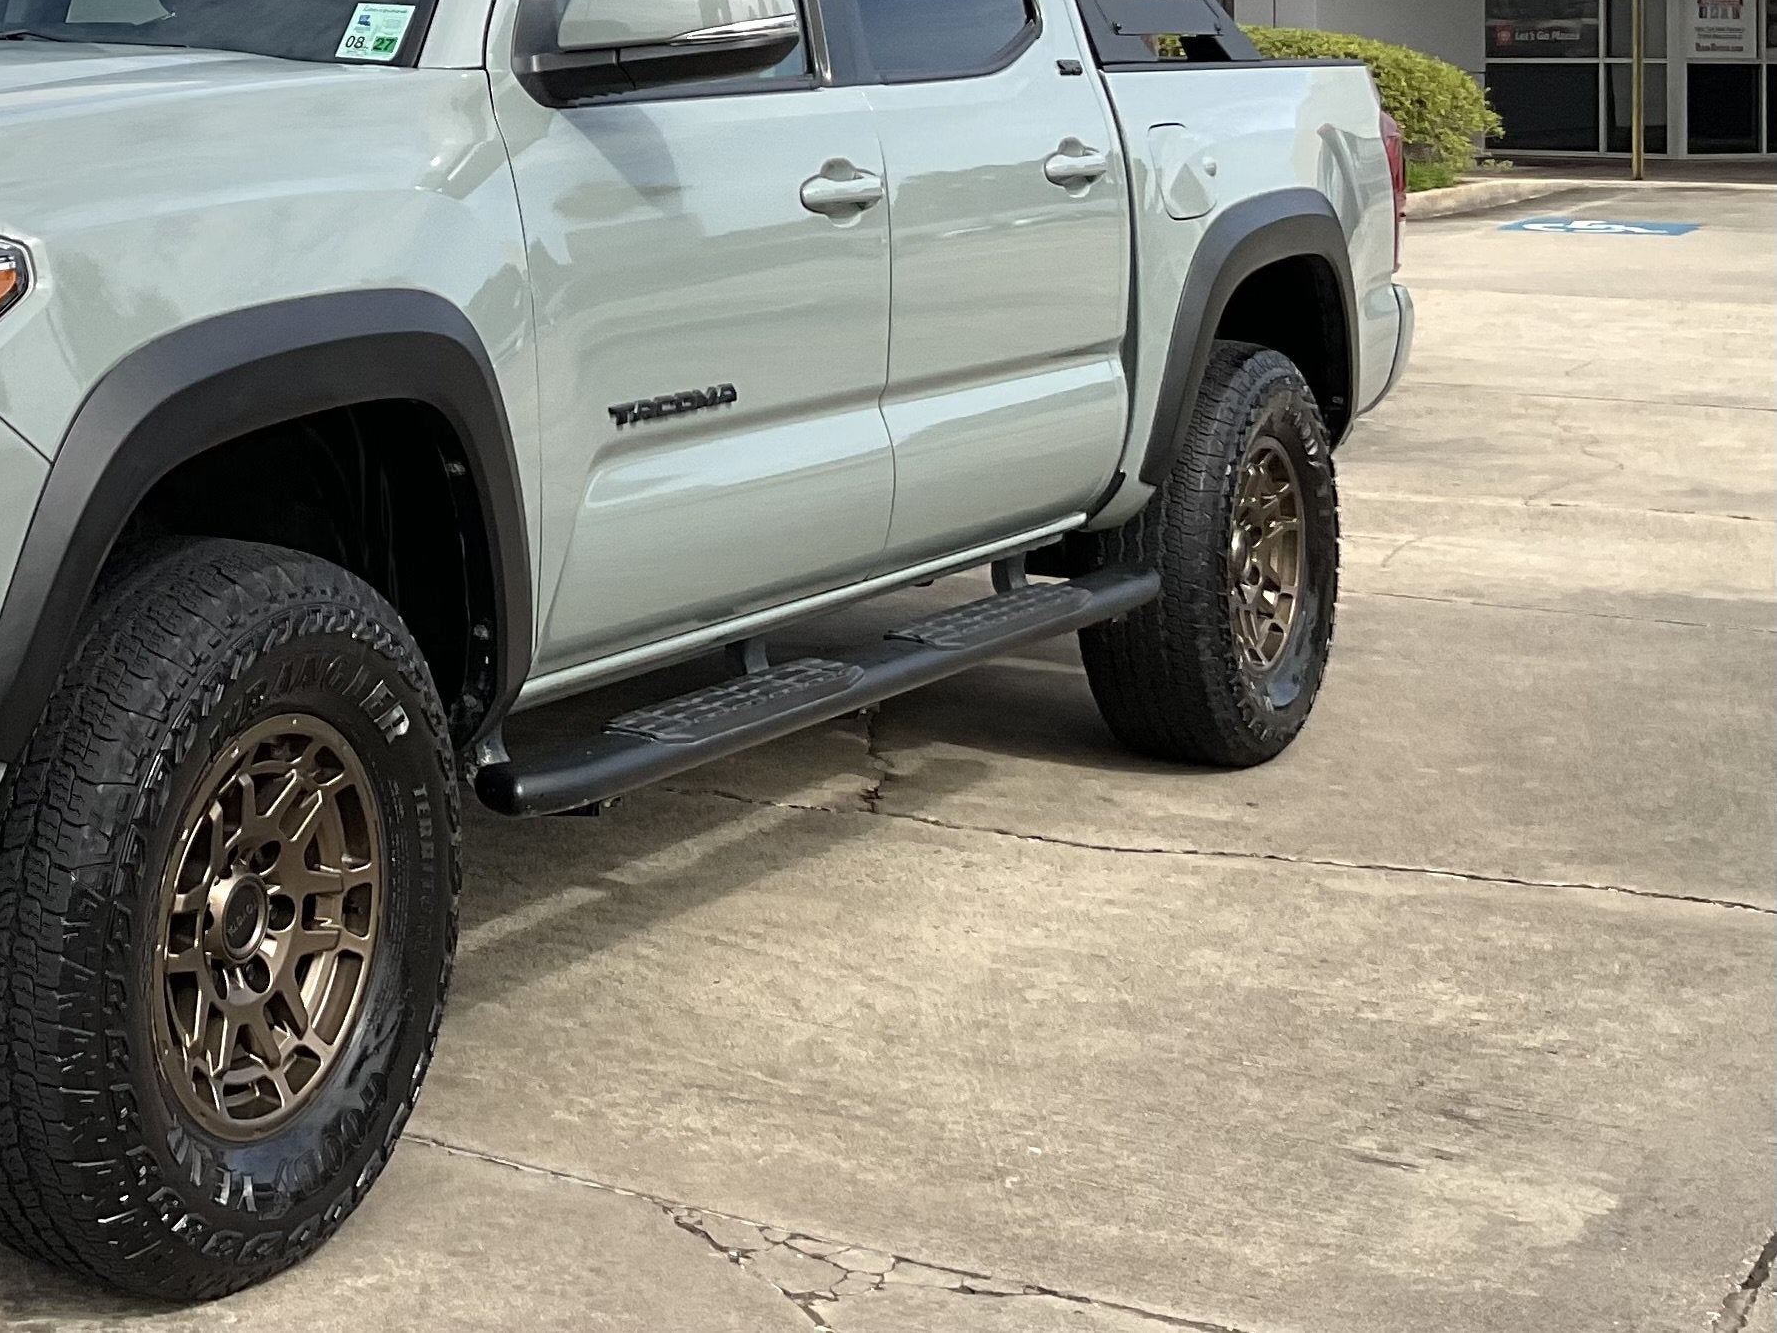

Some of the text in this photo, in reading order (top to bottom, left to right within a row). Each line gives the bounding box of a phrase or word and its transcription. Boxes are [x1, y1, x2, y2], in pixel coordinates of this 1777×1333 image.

[345, 35, 365, 49] 08
[373, 36, 397, 51] 27
[608, 382, 738, 426] TACOMA
